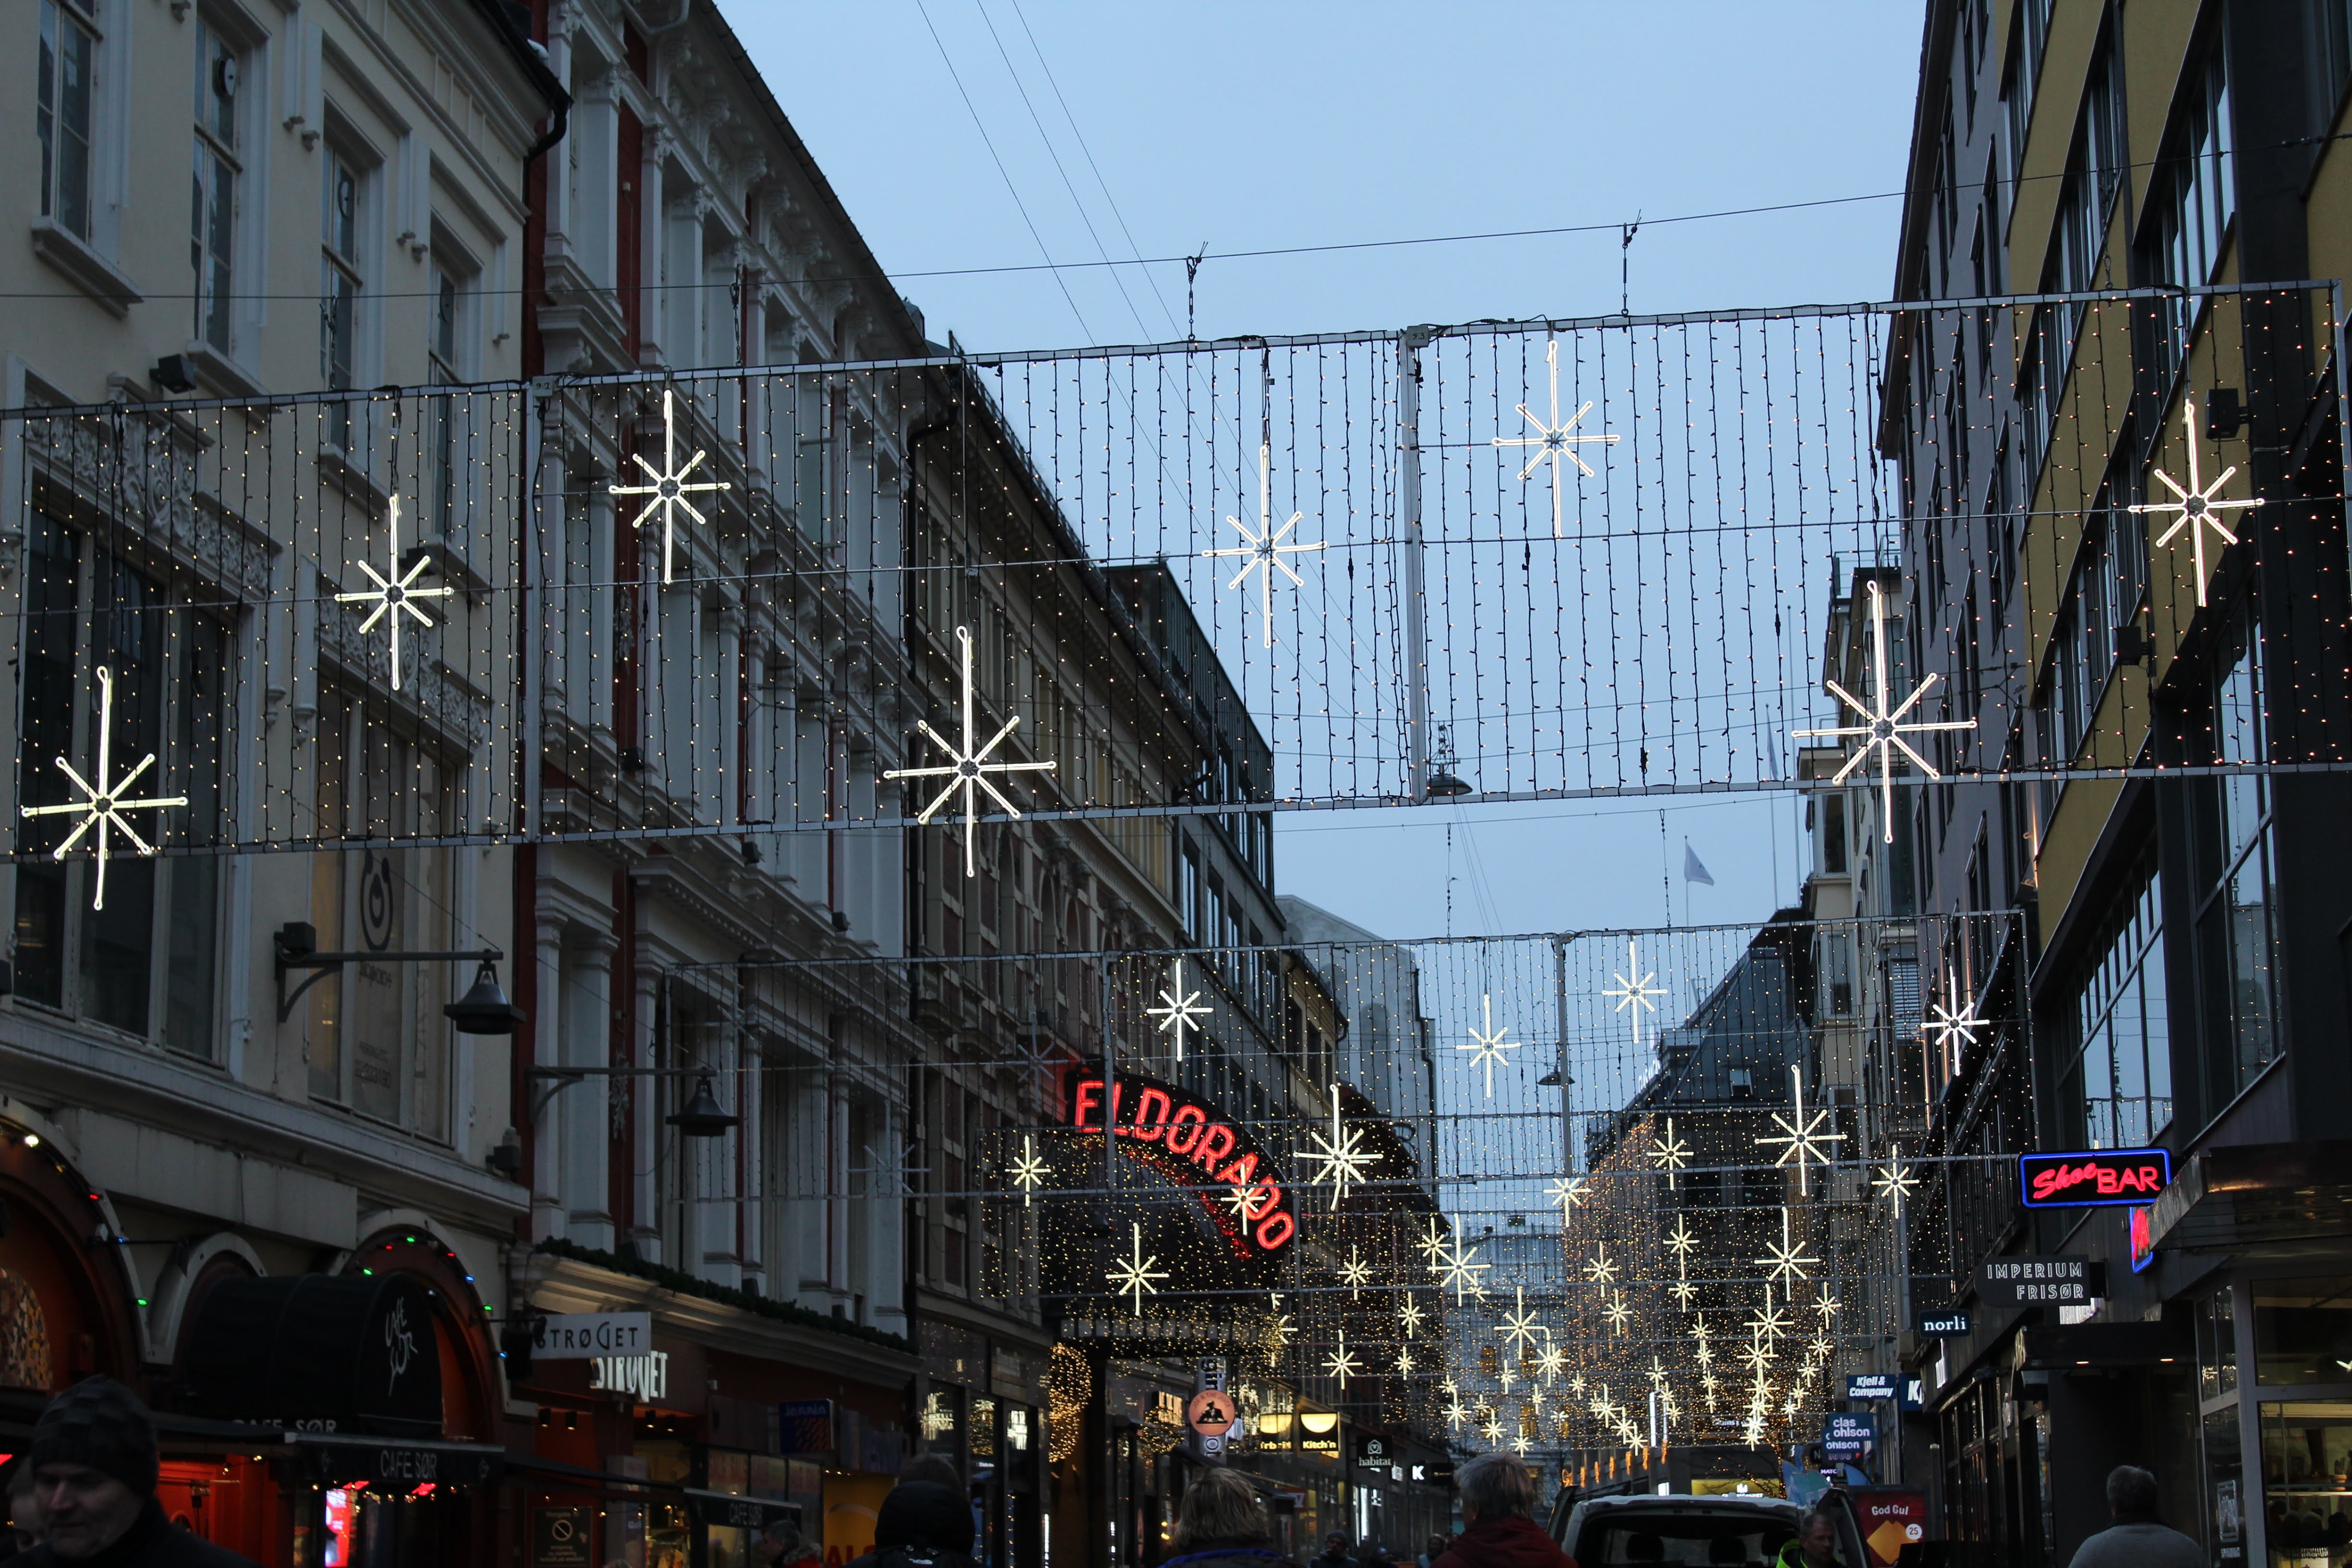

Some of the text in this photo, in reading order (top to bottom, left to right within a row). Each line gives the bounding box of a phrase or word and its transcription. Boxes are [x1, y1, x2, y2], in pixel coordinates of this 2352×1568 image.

[1075, 1080, 1295, 1250] ELDORADO
[2033, 1163, 2160, 1199] Shoe BAR
[1987, 1262, 2082, 1279] IMPERIUM
[2017, 1284, 2084, 1300] FRISØR
[1924, 1315, 1966, 1331] norli
[1856, 1376, 1885, 1387] Kjell &
[1849, 1387, 1893, 1398] Company
[1833, 1417, 1856, 1427] clas
[1833, 1427, 1870, 1437] ohlson
[1826, 1441, 1859, 1449] ohlson
[380, 1450, 437, 1479] CAFE SØR
[1359, 1457, 1391, 1466] habitat
[1871, 1505, 1891, 1515] God
